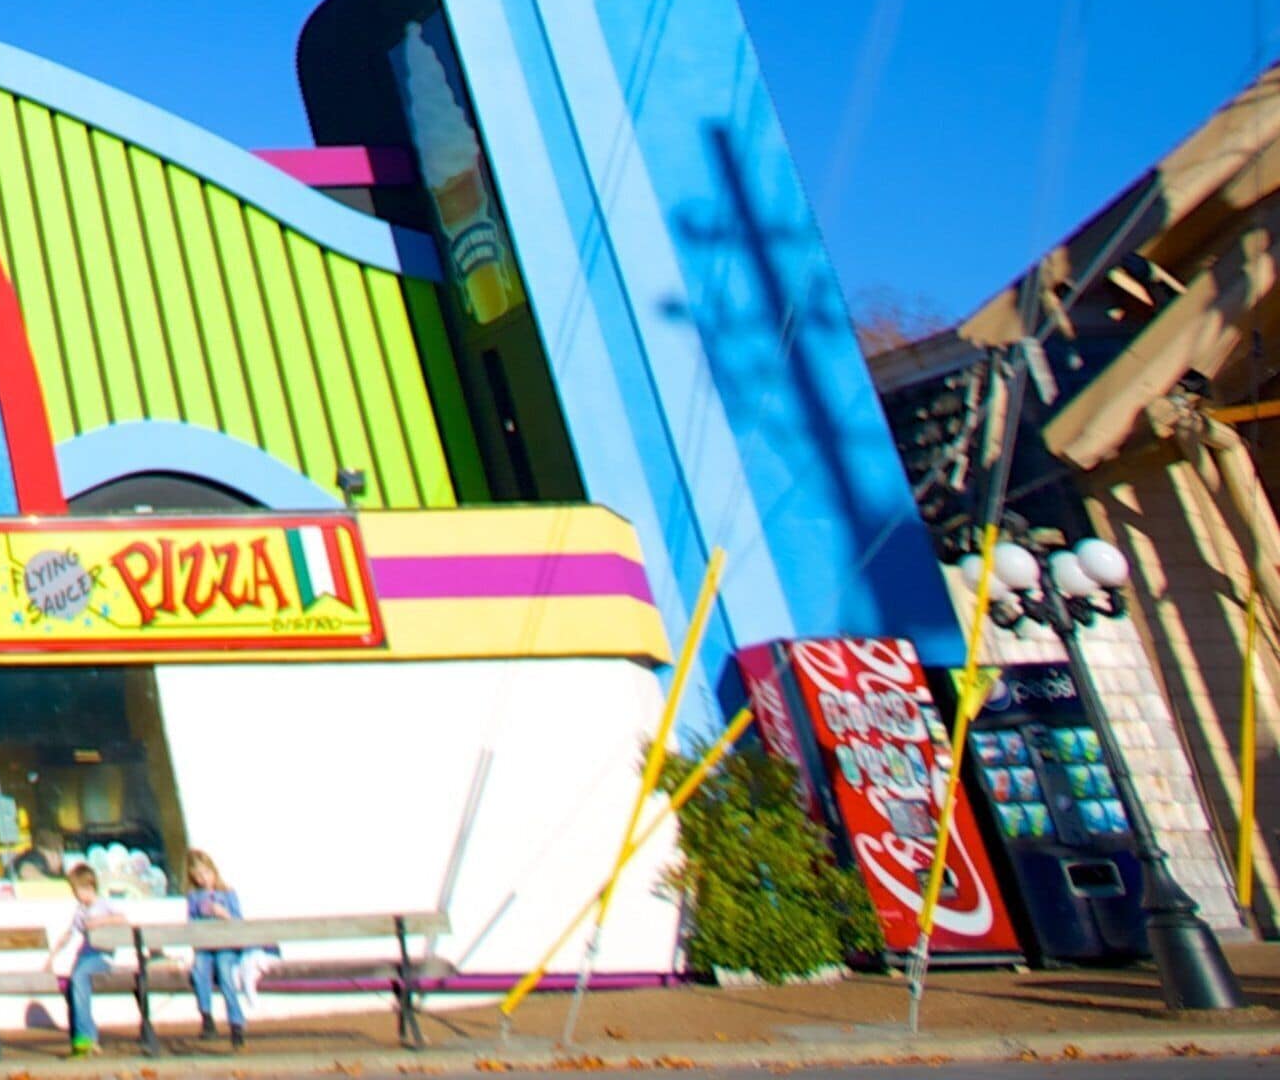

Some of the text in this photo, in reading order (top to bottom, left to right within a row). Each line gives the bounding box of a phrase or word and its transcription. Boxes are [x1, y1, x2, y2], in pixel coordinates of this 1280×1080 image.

[11, 546, 80, 598] FLYING
[27, 564, 108, 624] SAUCER
[108, 536, 290, 630] PIZZA
[271, 615, 342, 633] BISTRO
